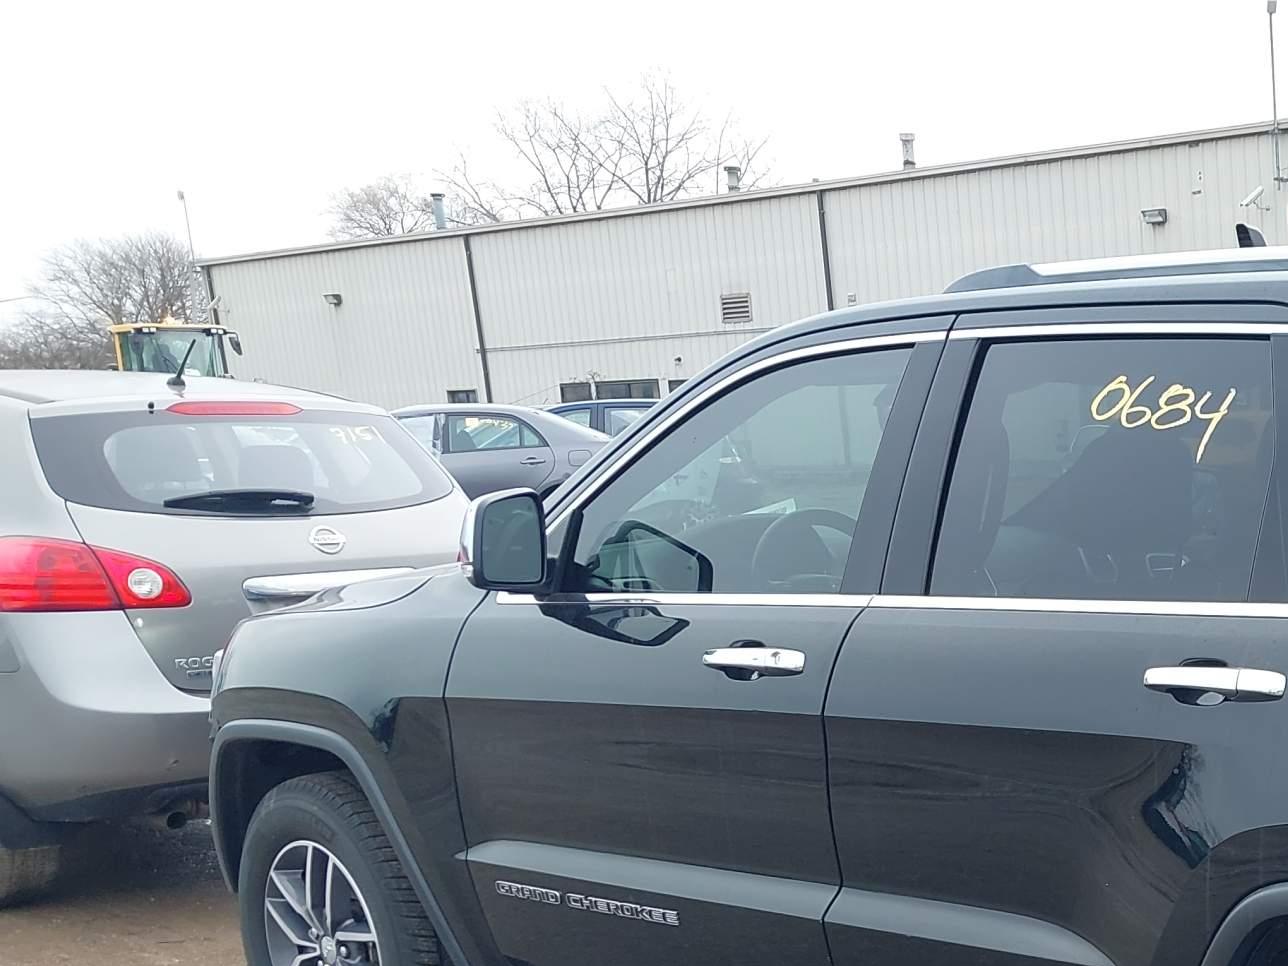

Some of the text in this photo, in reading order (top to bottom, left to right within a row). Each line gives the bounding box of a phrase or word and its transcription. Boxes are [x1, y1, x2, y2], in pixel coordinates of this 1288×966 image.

[1090, 375, 1237, 464] 0684
[495, 880, 680, 926] GRAND CHEROKEE
